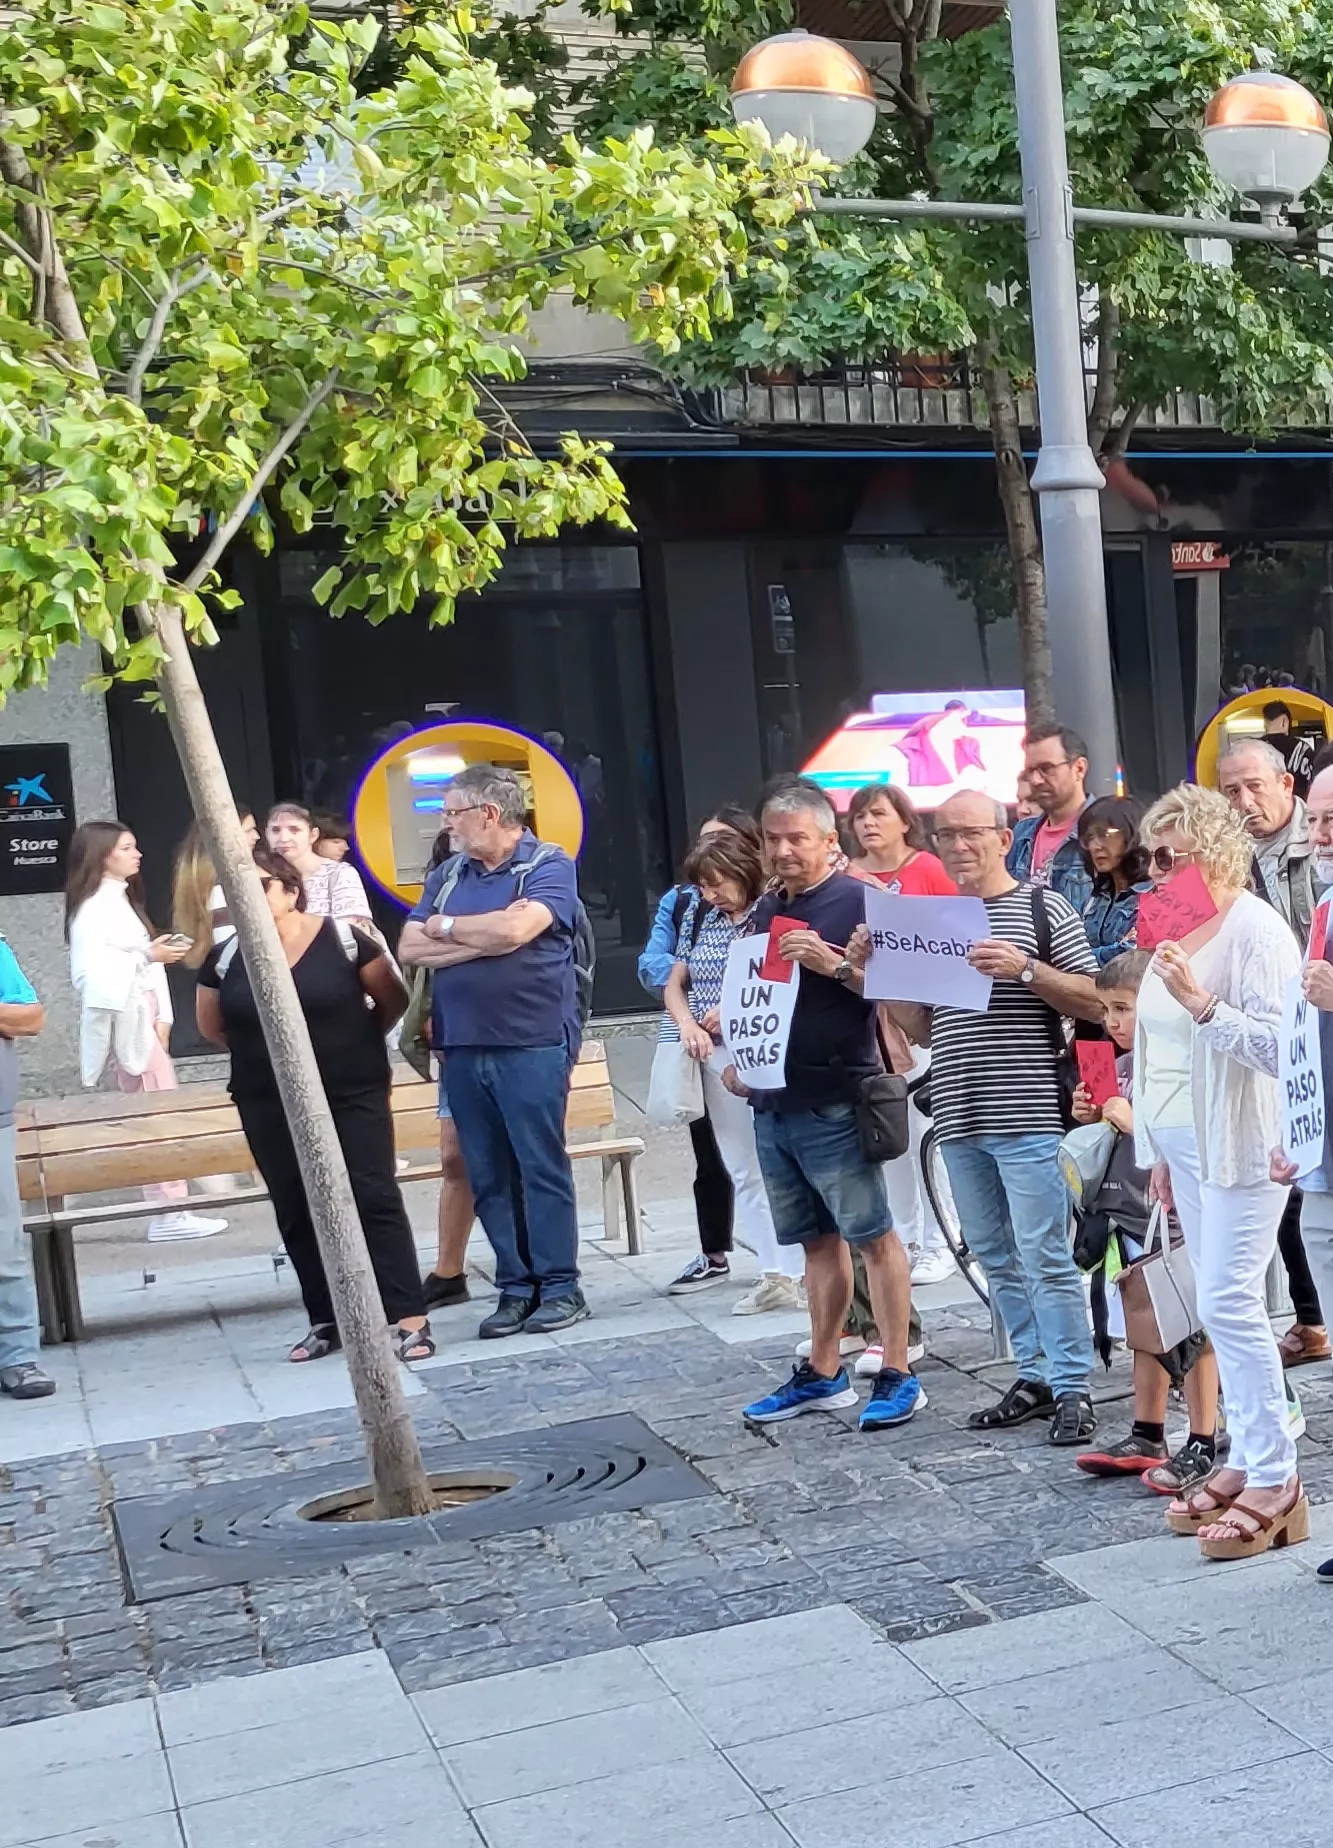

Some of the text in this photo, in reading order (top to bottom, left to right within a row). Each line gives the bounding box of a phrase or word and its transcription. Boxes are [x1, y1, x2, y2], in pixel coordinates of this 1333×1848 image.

[9, 838, 59, 852] Store
[740, 984, 773, 1009] UN
[729, 1012, 780, 1041] PASO
[1294, 1000, 1308, 1029] NI
[1290, 1033, 1308, 1067] UN
[1286, 1069, 1317, 1109] PASO
[1289, 1104, 1322, 1149] ATRÁS
